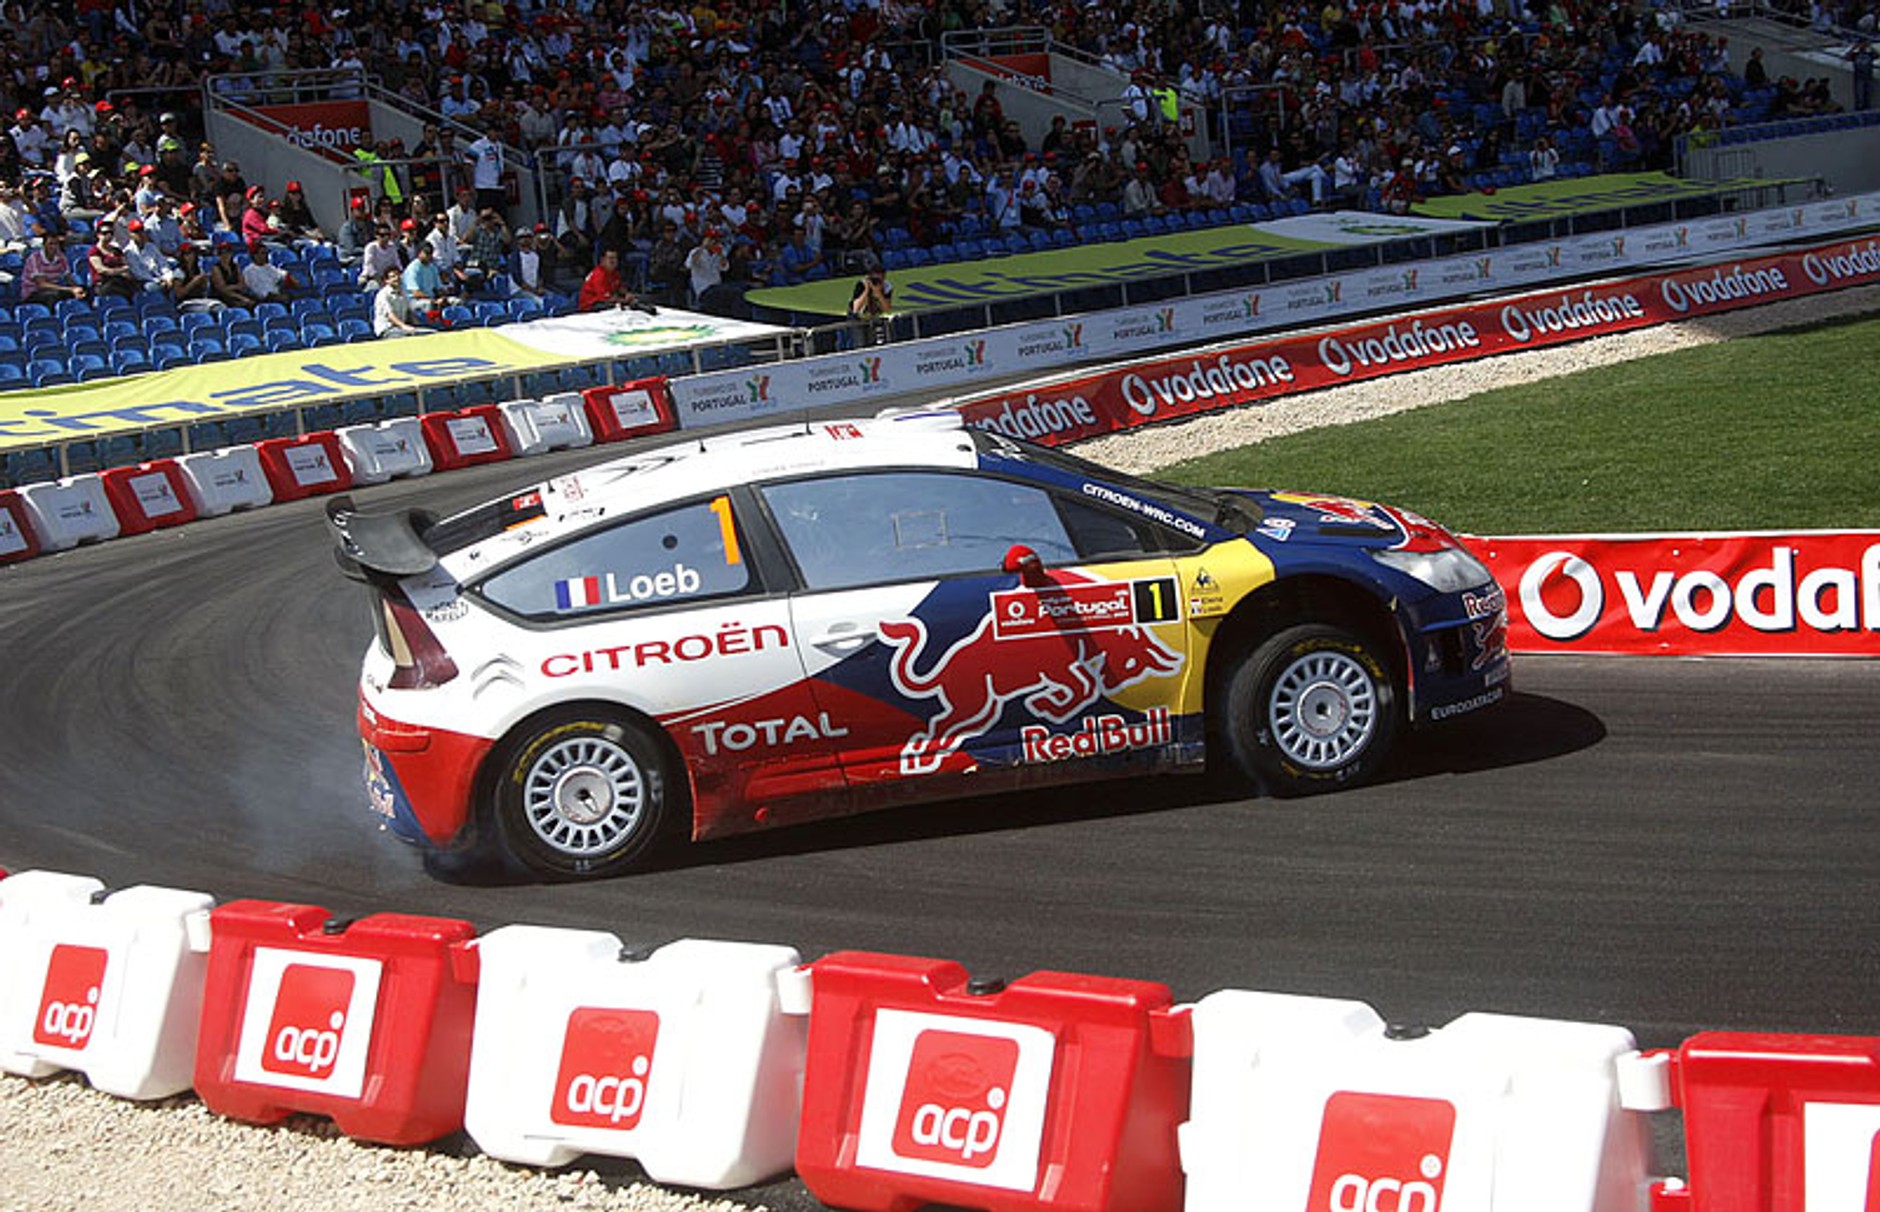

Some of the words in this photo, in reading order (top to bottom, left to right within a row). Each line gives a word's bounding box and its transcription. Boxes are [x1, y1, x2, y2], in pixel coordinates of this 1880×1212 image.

[1683, 264, 1789, 306] vodafone
[1113, 325, 1156, 340] PORTUGAL
[1526, 292, 1646, 335] vodafone
[1017, 340, 1063, 357] PORTUGAL
[1345, 319, 1481, 367] vodafone
[808, 376, 860, 393] PORTUGAL
[916, 358, 965, 375] PORTUGAL
[1151, 352, 1296, 405] vodafone
[691, 395, 747, 413] PORTUGAL
[708, 495, 742, 565] 1
[1082, 482, 1206, 539] CITROEN-WRC.COM
[605, 563, 701, 602] Loeb
[1148, 582, 1163, 619] 1
[690, 711, 849, 756] TOTAL
[1021, 716, 1098, 763] Red
[1098, 705, 1172, 752] Bull
[43, 999, 94, 1045] acp
[275, 1025, 339, 1072] acp
[567, 1073, 643, 1123] acp
[911, 1102, 999, 1160] acp
